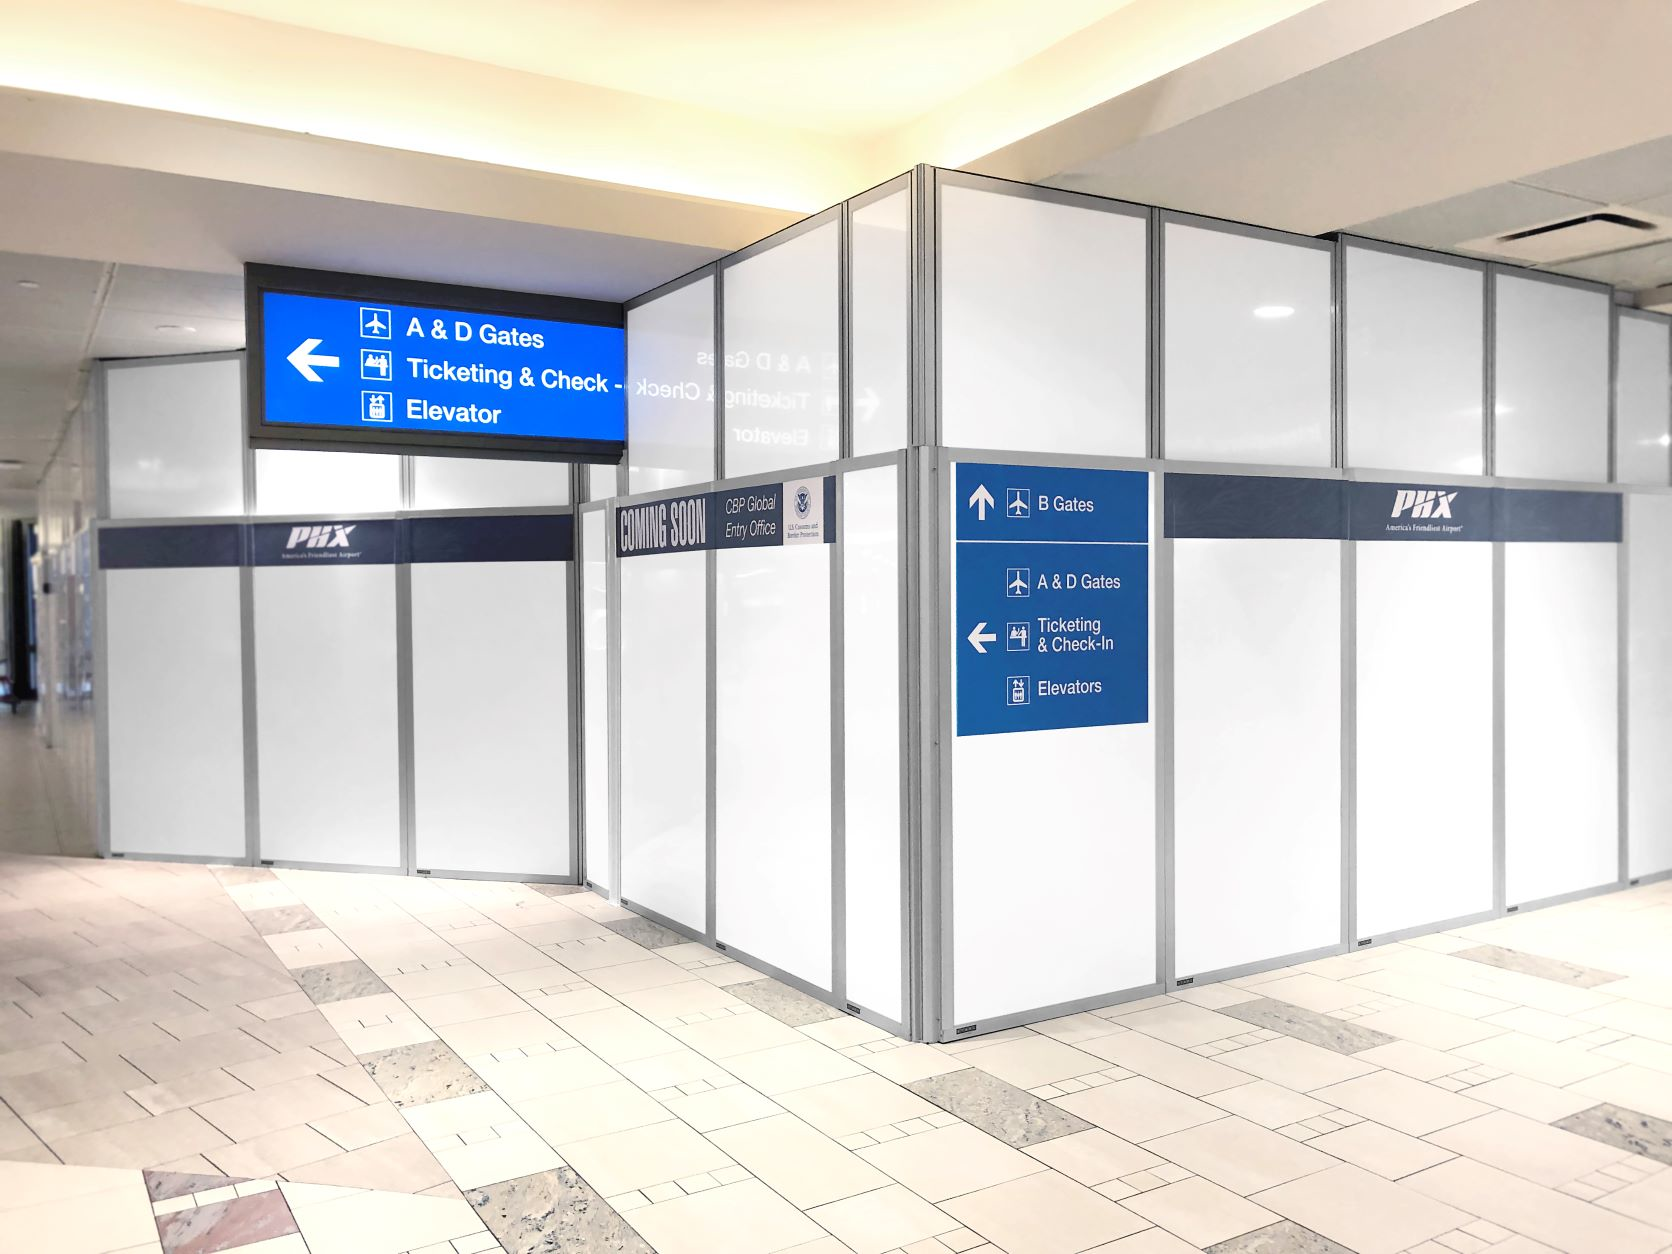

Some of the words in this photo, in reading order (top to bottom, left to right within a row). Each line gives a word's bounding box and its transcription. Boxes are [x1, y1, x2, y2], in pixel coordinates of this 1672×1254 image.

[406, 317, 425, 337] A
[431, 319, 448, 340] &
[455, 321, 472, 342] D
[479, 323, 545, 349] Gates
[406, 357, 513, 390] Ticketing
[519, 366, 535, 388] &
[541, 368, 609, 393] Check
[406, 398, 501, 424] Elevator
[725, 497, 746, 515] CBP
[747, 493, 777, 512] Global
[1038, 495, 1049, 511] B
[1053, 495, 1095, 512] Gates
[1390, 490, 1458, 518] PHX
[620, 503, 667, 552] COMING
[670, 497, 706, 547] SOON
[725, 522, 748, 541] Entry
[749, 519, 776, 537] Office
[286, 525, 357, 549] PHX
[1037, 574, 1048, 589] A
[1052, 573, 1062, 590] &
[1066, 573, 1077, 589] D
[1081, 573, 1121, 590] Gates
[1037, 616, 1101, 635] Ticketing
[1037, 636, 1048, 652] &
[1052, 635, 1114, 652] Check-In
[1038, 680, 1102, 696] Elevators
